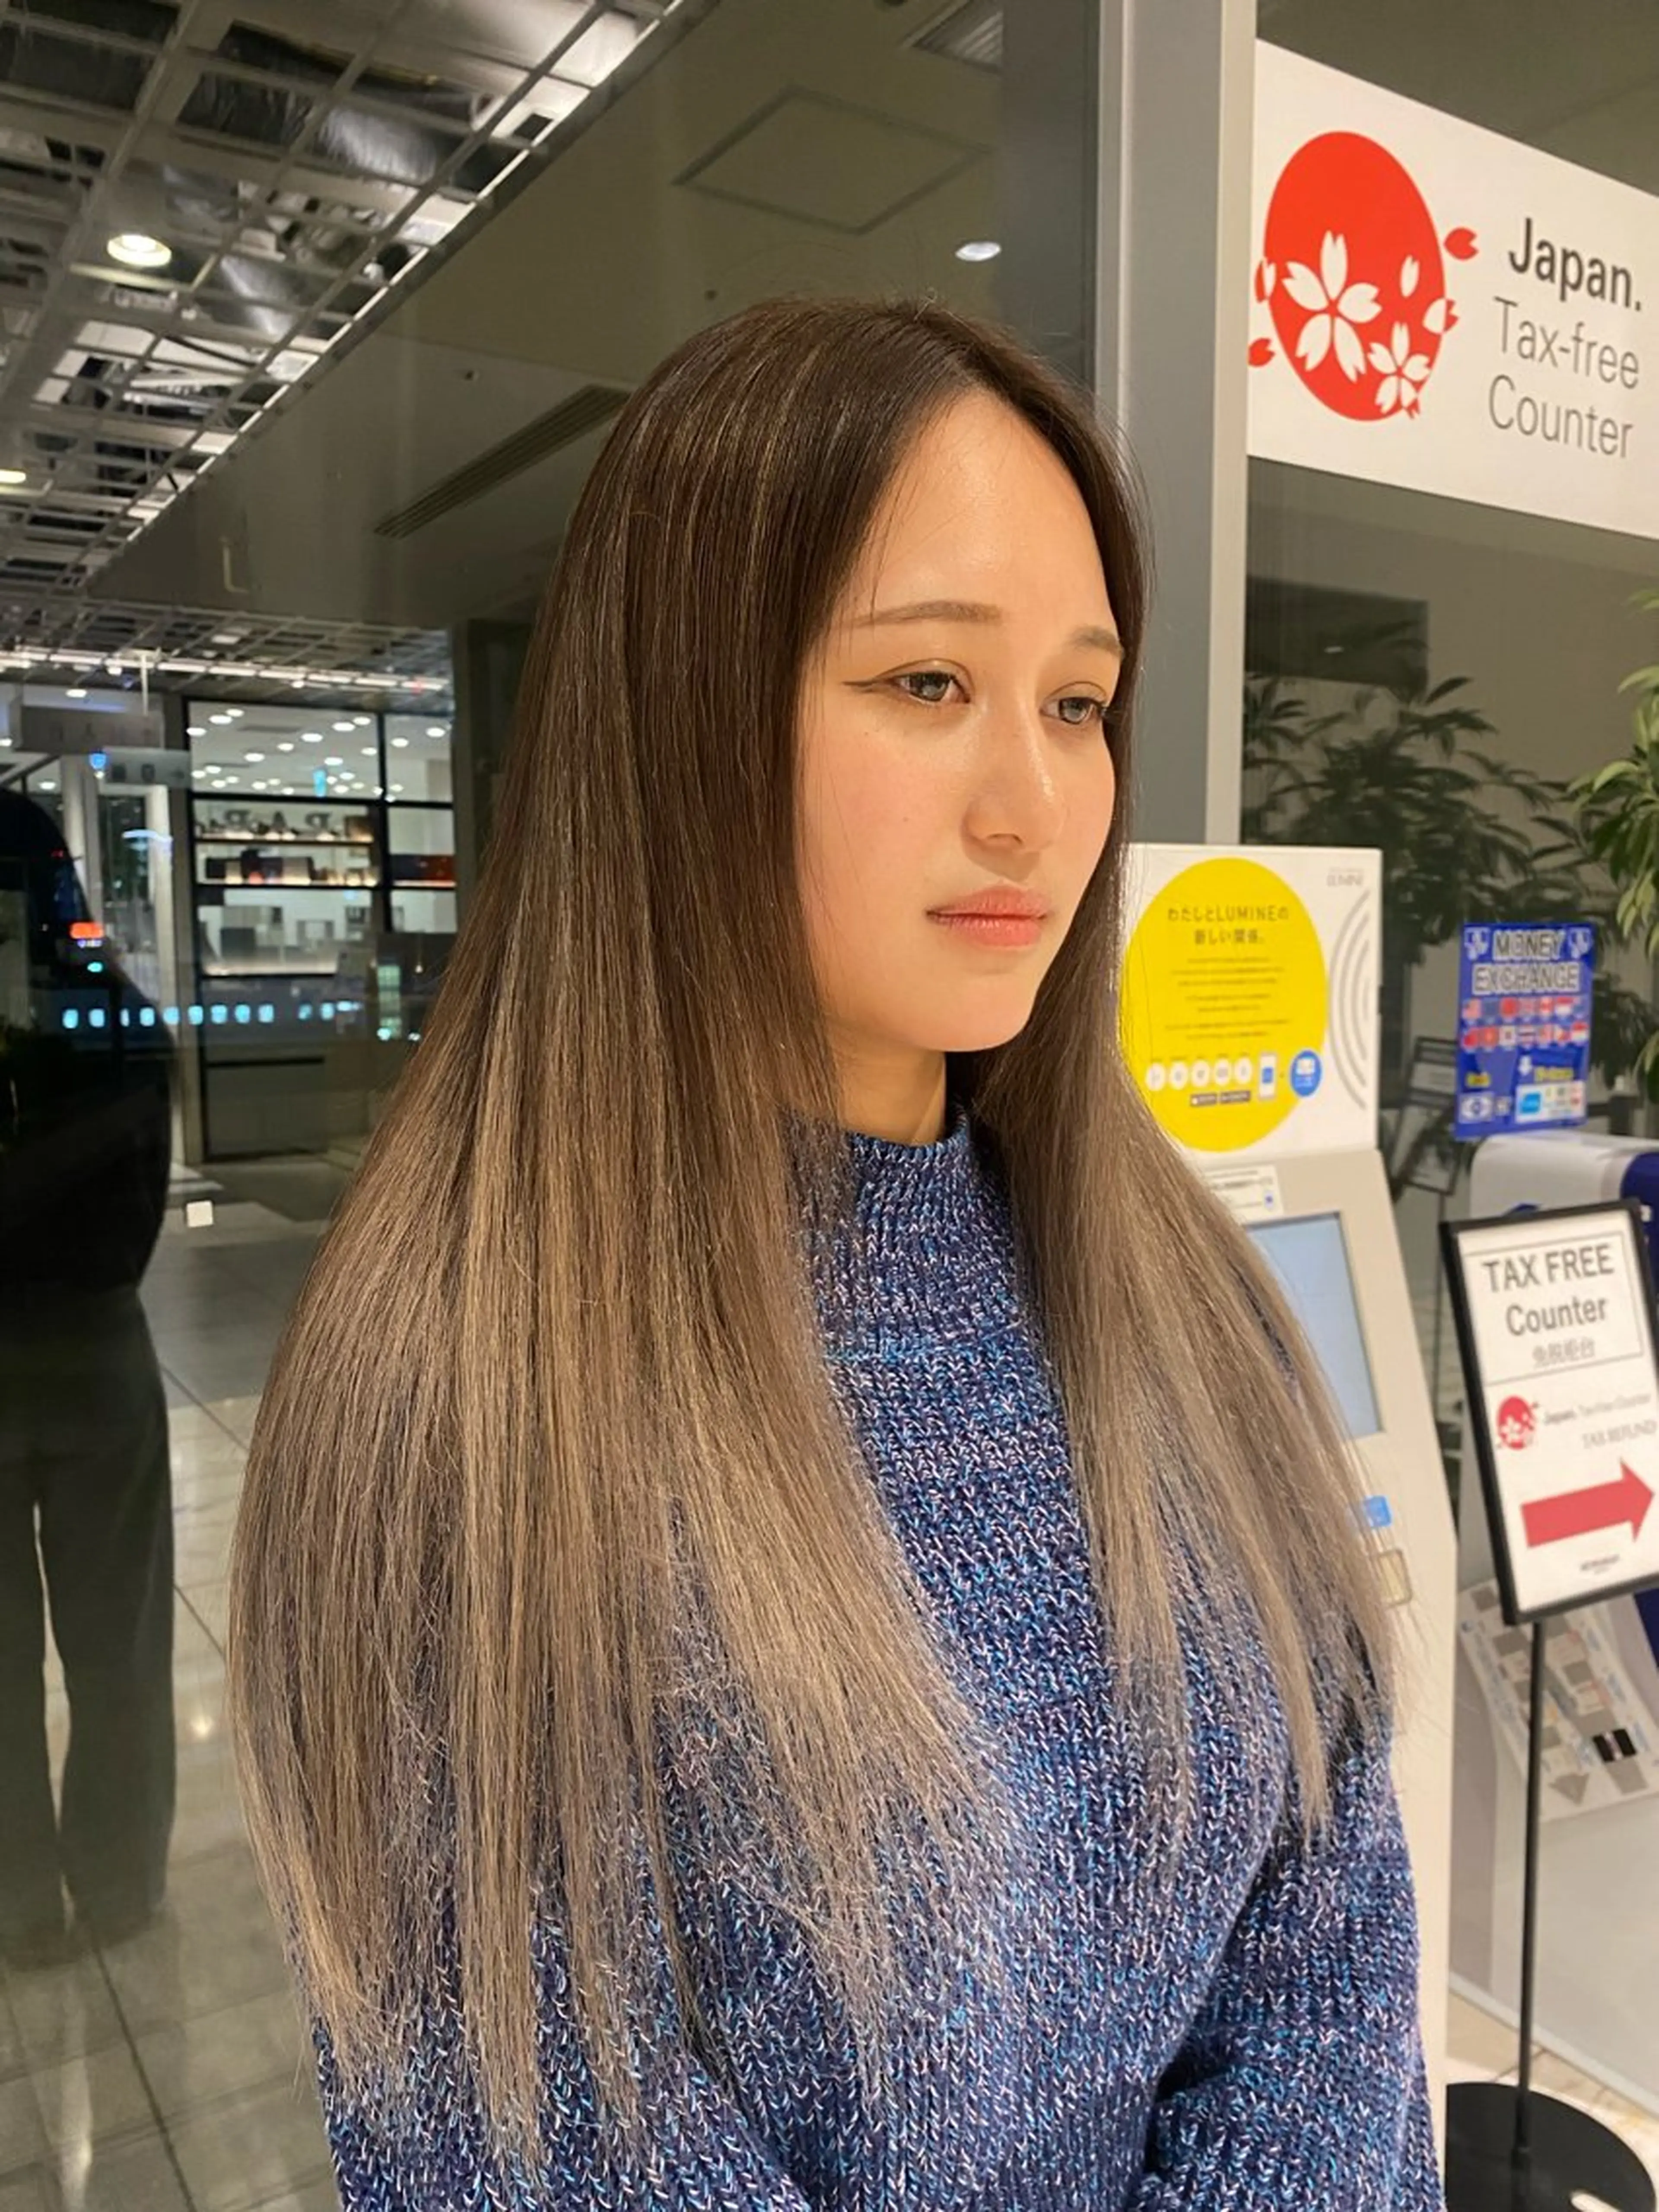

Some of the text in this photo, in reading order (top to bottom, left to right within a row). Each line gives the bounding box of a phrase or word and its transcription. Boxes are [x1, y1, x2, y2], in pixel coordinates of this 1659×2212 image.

[1507, 216, 1643, 313] Japan.
[1493, 295, 1640, 391] Tax-free
[1488, 373, 1634, 459] Counter
[1494, 930, 1566, 960] MONEY
[1474, 963, 1580, 995] EXCHANGE
[1481, 1243, 1615, 1293] TAX FREE
[1506, 1296, 1607, 1337] Counter
